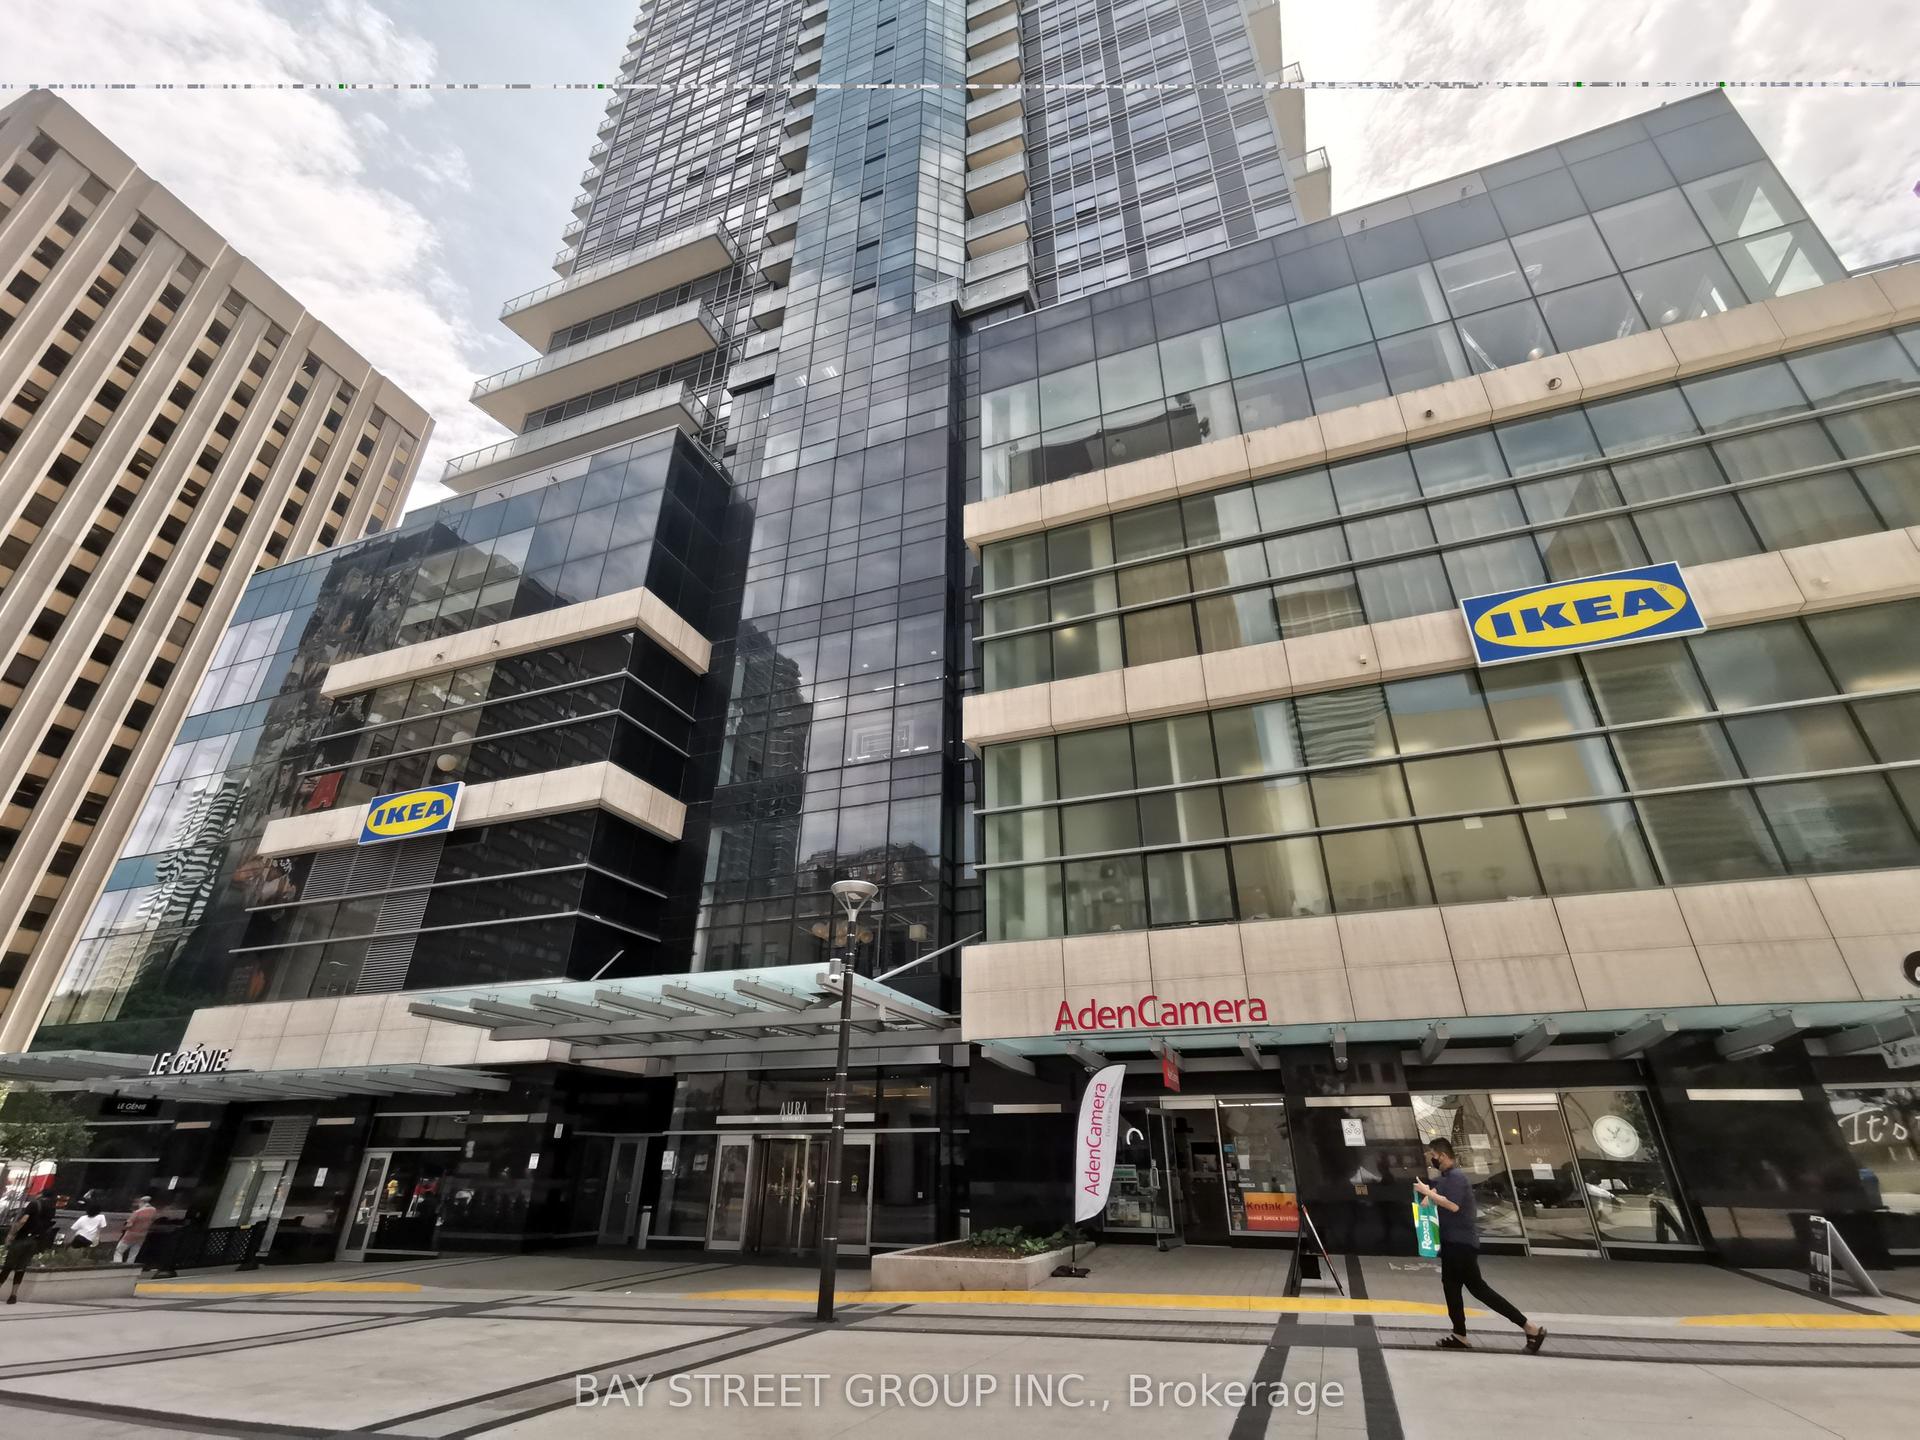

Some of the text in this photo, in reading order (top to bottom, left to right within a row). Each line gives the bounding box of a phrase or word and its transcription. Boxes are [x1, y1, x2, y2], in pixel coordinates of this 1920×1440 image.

[1490, 587, 1675, 638] IKEA
[373, 799, 445, 827] IKEA
[1054, 995, 1268, 1032] AdenCamera
[148, 1043, 232, 1076] LE GÉNIE
[780, 1101, 807, 1116] AURA
[1838, 1108, 1908, 1145] It's
[1084, 1082, 1108, 1197] AdenCamera
[1246, 1201, 1281, 1211] Kodak
[1420, 1214, 1433, 1250] Rexall
